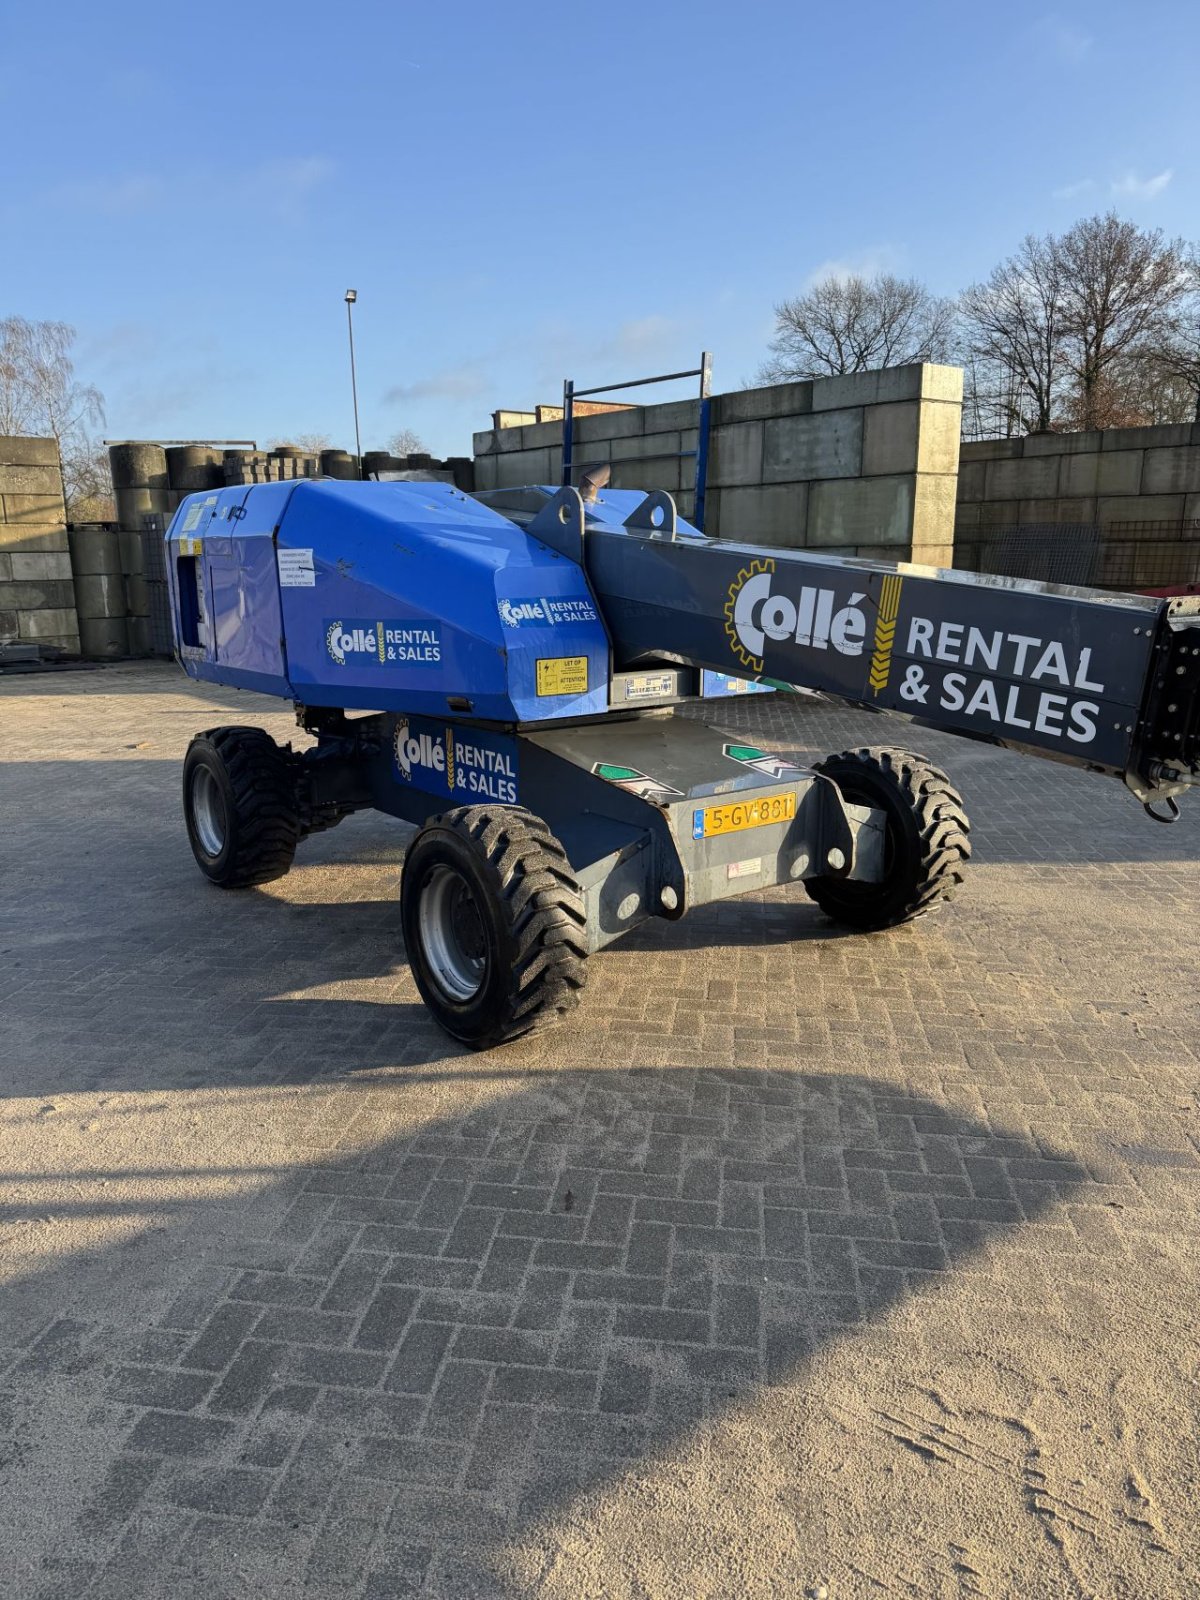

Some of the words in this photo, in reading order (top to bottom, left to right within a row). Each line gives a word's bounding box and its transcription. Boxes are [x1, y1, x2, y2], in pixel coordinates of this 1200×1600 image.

[502, 603, 545, 625] Collé
[549, 601, 593, 612] RENTAL
[554, 613, 562, 622] &
[564, 611, 597, 621] SALES
[734, 573, 867, 657] Collé
[330, 626, 377, 659] Collé
[385, 629, 440, 645] RENTAL
[387, 646, 397, 660] &
[398, 646, 441, 661] SALES
[906, 616, 1105, 693] RENTAL
[899, 664, 930, 704] &
[939, 672, 1100, 743] SALES
[397, 726, 446, 772] Collé
[455, 742, 516, 778] RENTAL
[456, 768, 467, 789] &
[469, 771, 517, 803] SALES
[712, 798, 788, 829] 5-GV-881
